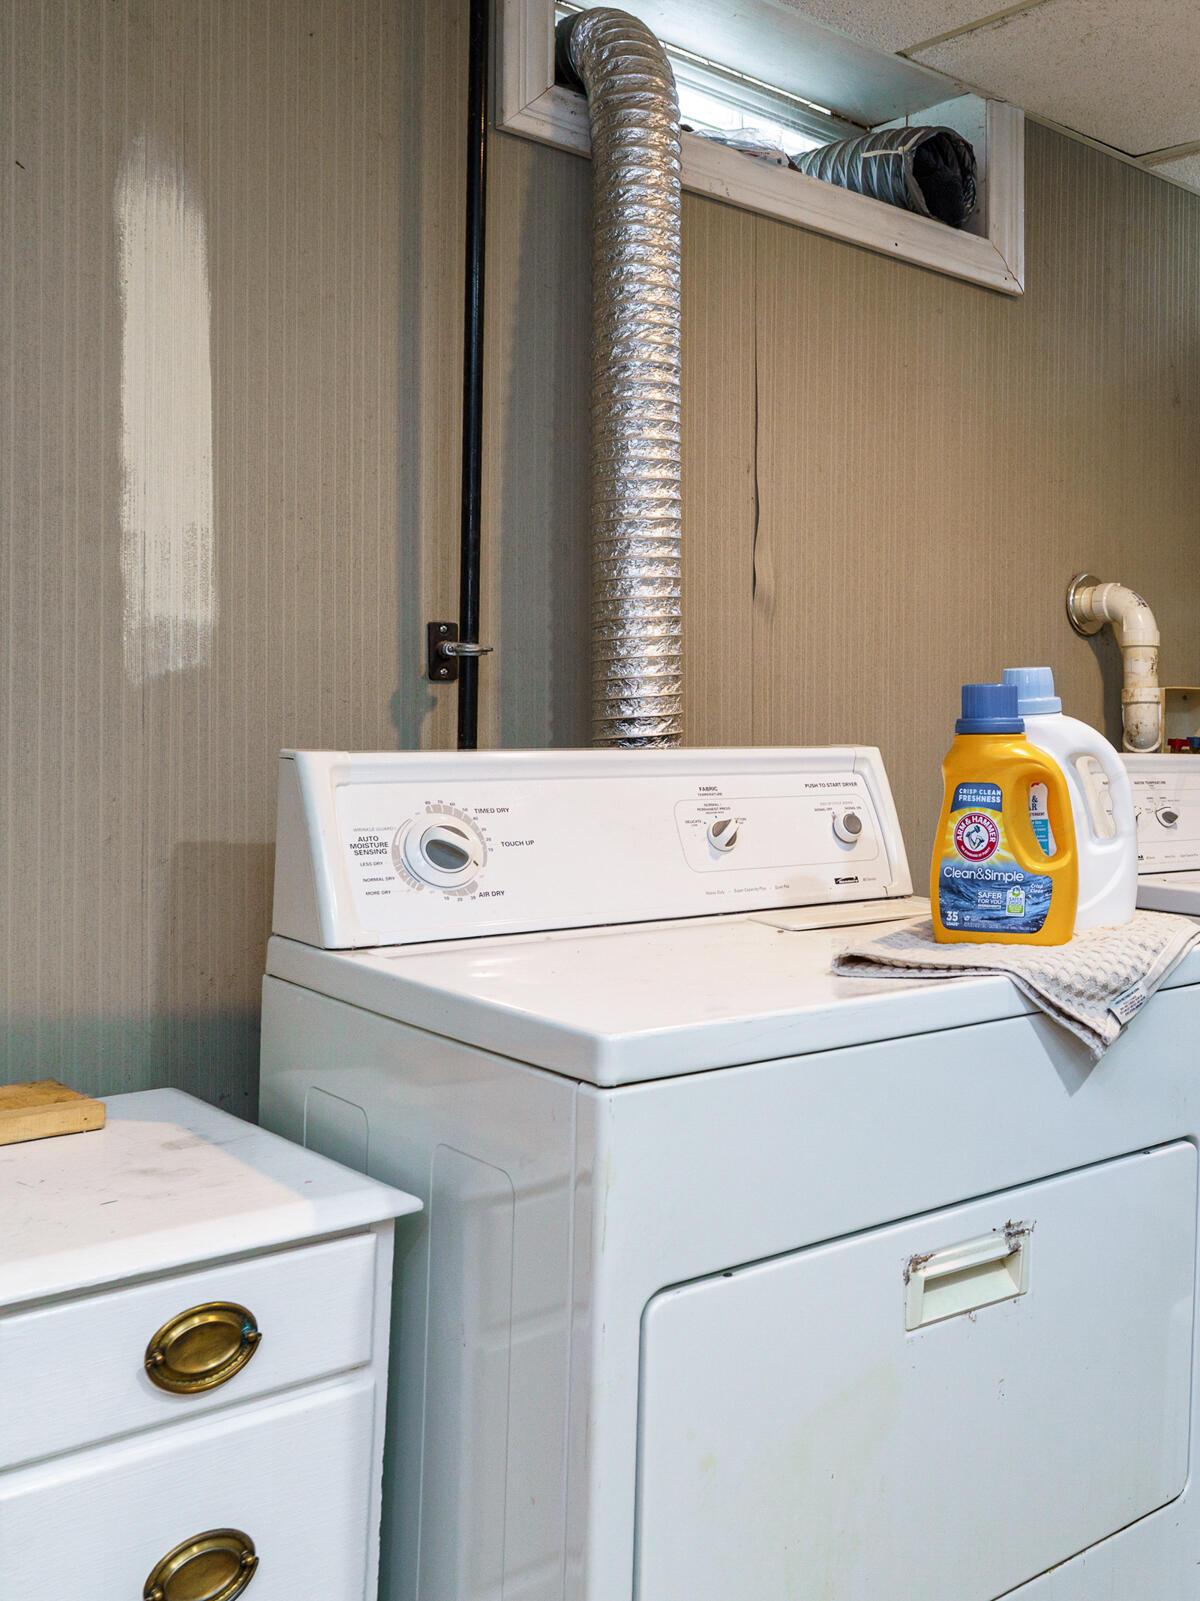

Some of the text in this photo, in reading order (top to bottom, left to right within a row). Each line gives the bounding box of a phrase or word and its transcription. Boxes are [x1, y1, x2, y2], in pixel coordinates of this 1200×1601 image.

[958, 795, 1001, 804] FRESHNESS
[972, 816, 996, 842] HAMMER
[350, 842, 390, 850] MOISTURE
[944, 866, 1024, 884] Clean&Simple
[946, 911, 958, 922] 35
